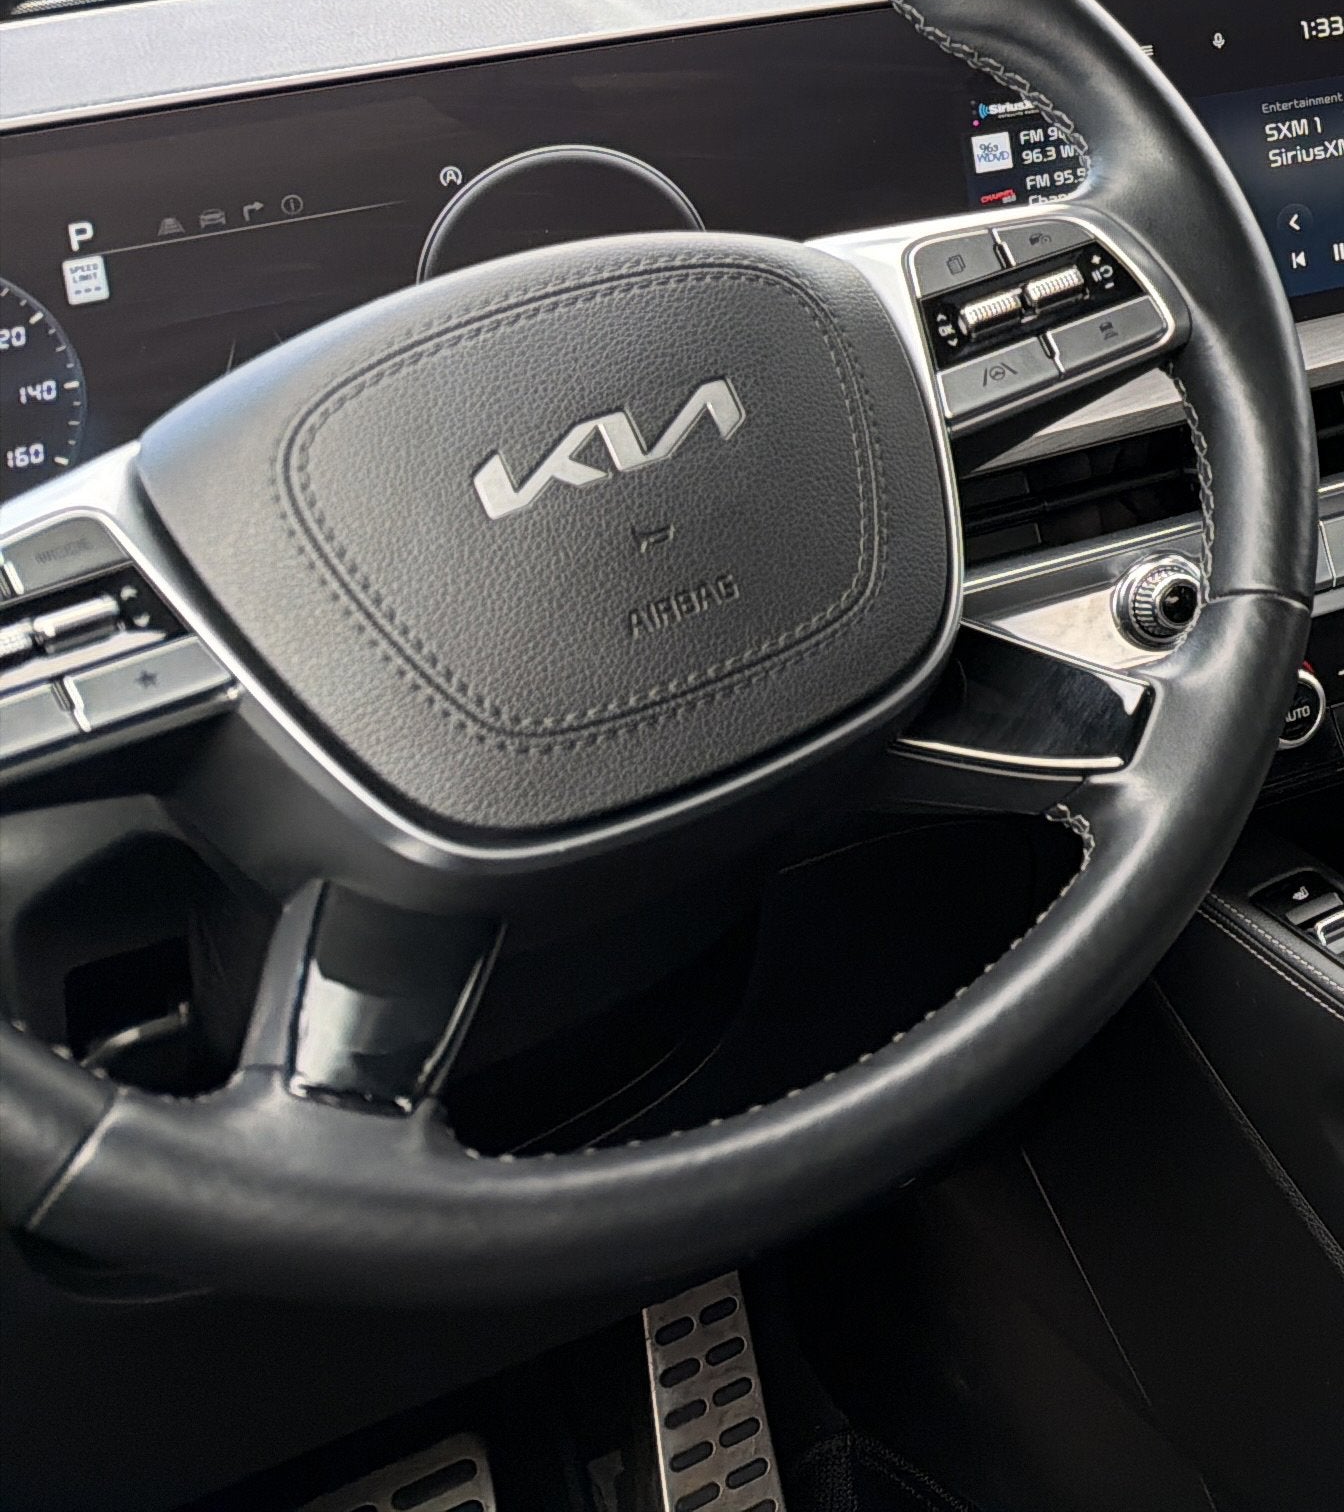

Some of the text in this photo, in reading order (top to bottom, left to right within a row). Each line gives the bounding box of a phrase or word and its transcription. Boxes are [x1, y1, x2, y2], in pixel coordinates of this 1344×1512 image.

[1301, 16, 1344, 39] 1:33
[1261, 92, 1344, 114] Entertainment
[1019, 128, 1044, 145] FM
[1264, 117, 1323, 142] SXM 1
[1021, 146, 1057, 165] 96.3
[1025, 173, 1051, 191] FM
[68, 220, 94, 252] P
[69, 263, 98, 275] SPEED
[19, 380, 57, 404] 140
[6, 443, 45, 469] 160
[472, 375, 747, 521] KIA
[629, 574, 740, 639] AIRBAG
